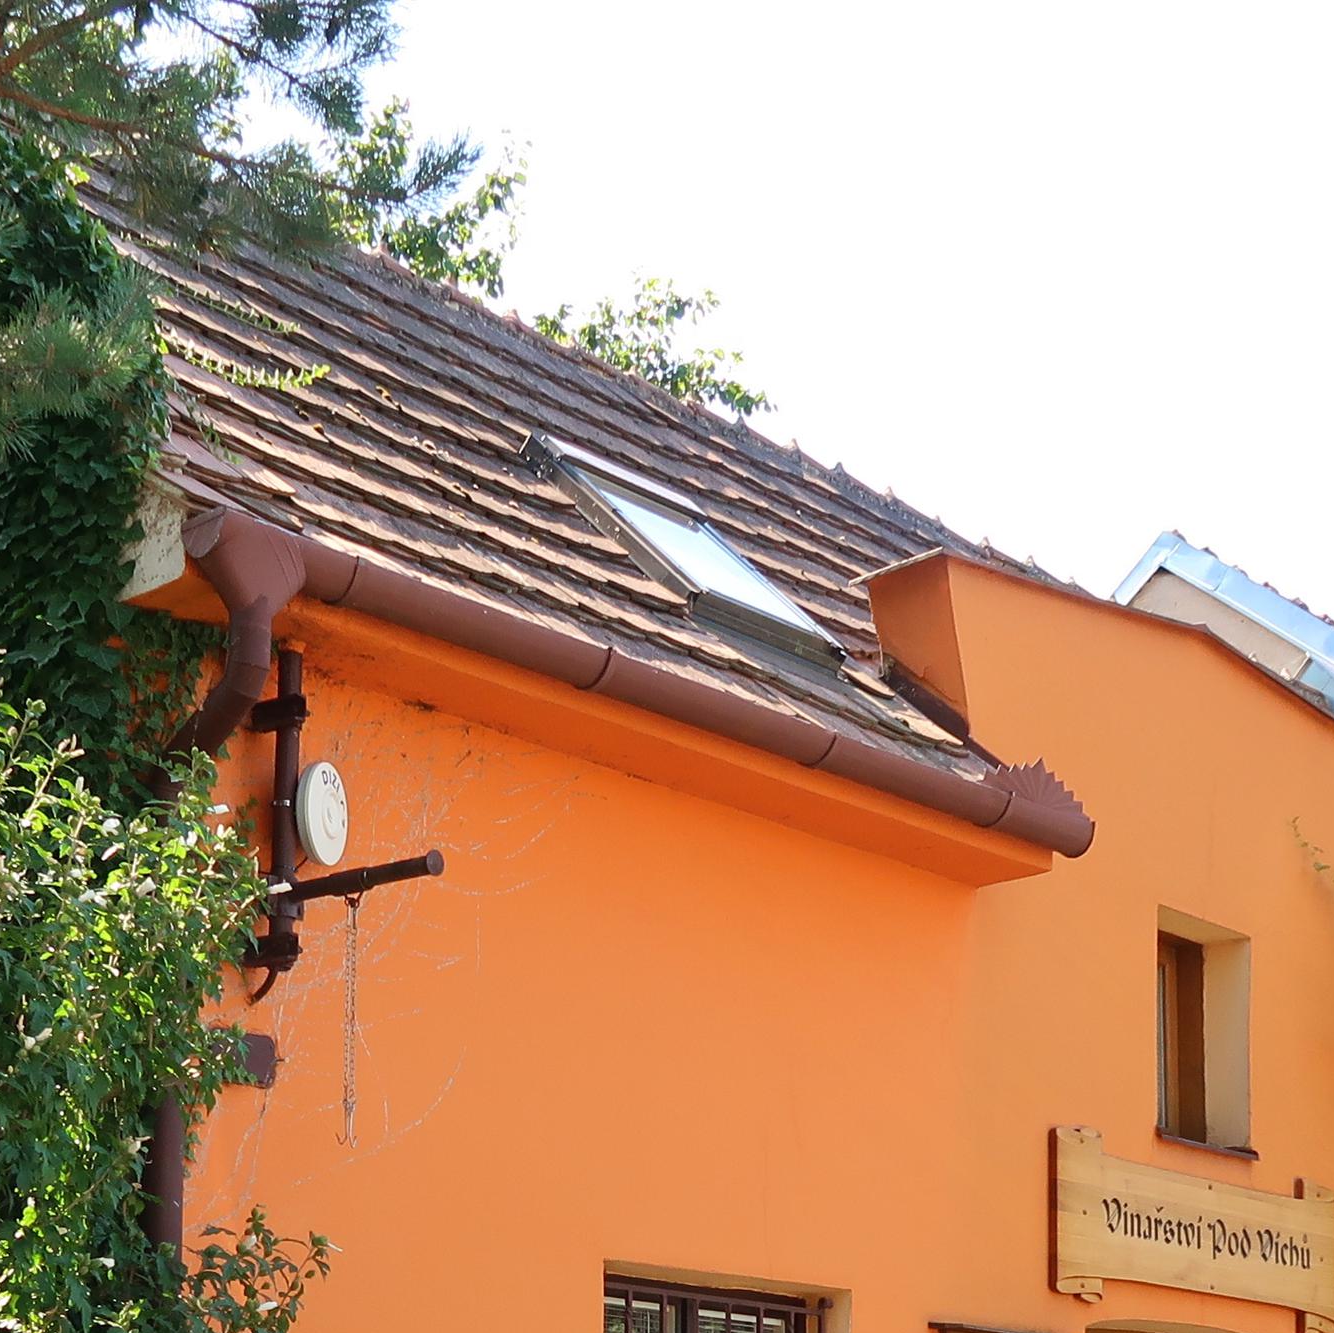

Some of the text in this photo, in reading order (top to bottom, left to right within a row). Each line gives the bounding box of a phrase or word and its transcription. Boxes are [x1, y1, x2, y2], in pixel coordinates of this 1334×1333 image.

[1102, 1197, 1311, 1270] Vinařství Pod Víchů
